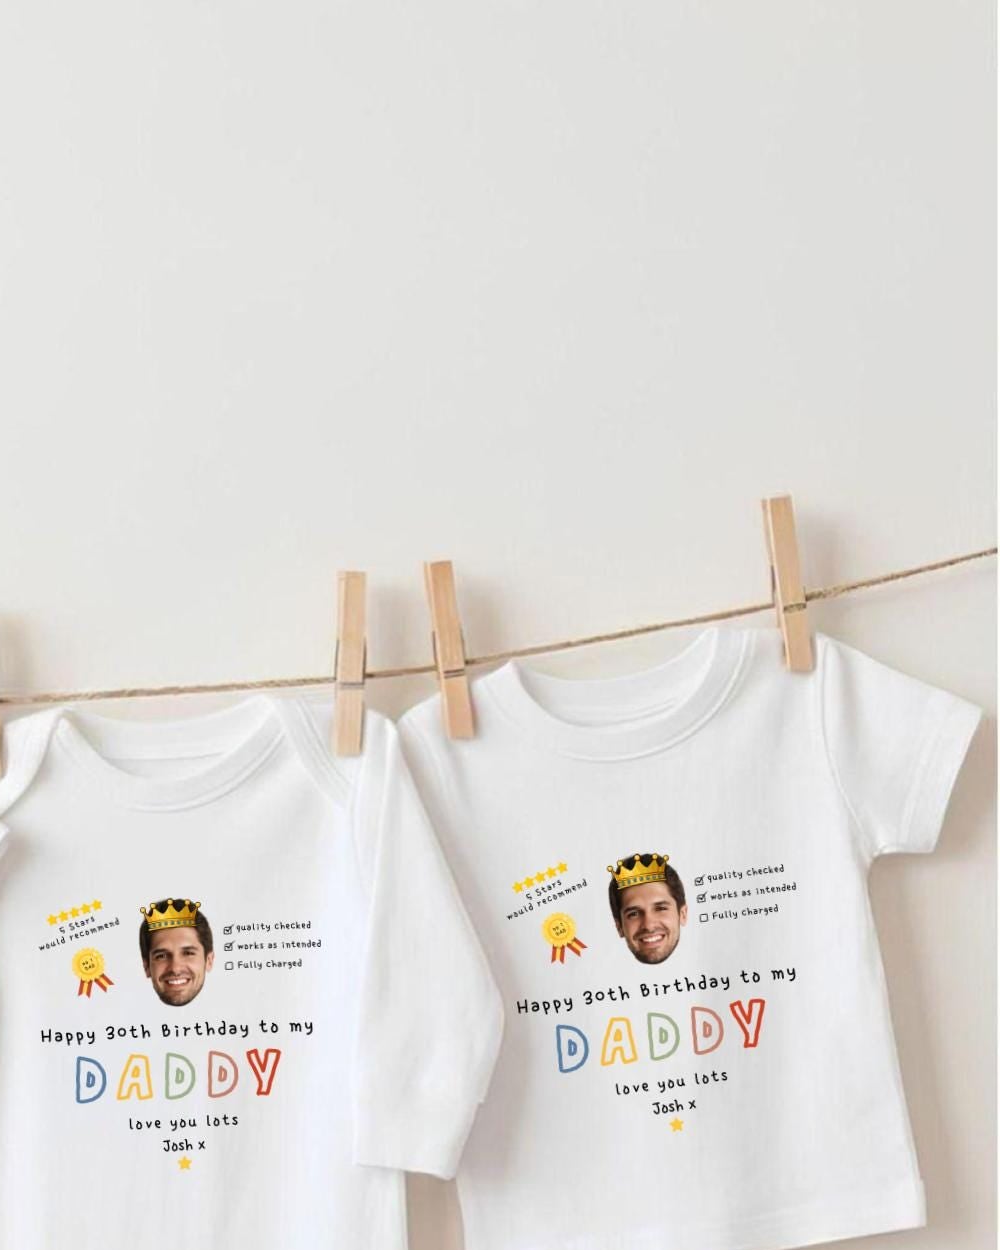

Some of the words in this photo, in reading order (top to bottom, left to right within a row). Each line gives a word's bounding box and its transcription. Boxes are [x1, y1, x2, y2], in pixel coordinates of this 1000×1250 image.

[707, 870, 744, 883] quality
[746, 864, 785, 877] checked
[525, 892, 533, 901] 5
[534, 878, 562, 896] Stars
[710, 890, 738, 902] works
[741, 888, 752, 898] as
[755, 882, 798, 896] intended
[506, 902, 534, 921] would
[536, 879, 588, 908] recommend
[741, 904, 780, 918] charged
[38, 936, 66, 952] would
[69, 918, 120, 942] recommend
[58, 926, 66, 935] 5
[68, 916, 96, 932] Stars
[236, 922, 272, 933] quality
[274, 920, 312, 931] checked
[237, 939, 265, 950] works
[268, 940, 278, 949] as
[281, 939, 322, 949] intended
[266, 958, 303, 970] charged
[516, 996, 574, 1016] Happy
[582, 985, 631, 1006] 30th
[640, 974, 731, 998] Birthday
[740, 968, 761, 984] to
[770, 966, 797, 983] my
[40, 1028, 96, 1046] Happy
[106, 1024, 152, 1040] 30th
[162, 1020, 250, 1039] Birthday
[258, 1019, 279, 1034] to
[289, 1018, 314, 1035] my
[556, 998, 766, 1074] DADDY
[75, 1048, 282, 1104] DADDY
[615, 1080, 650, 1096] love
[658, 1077, 686, 1093] you
[694, 1068, 729, 1086] lots
[652, 1098, 684, 1115] Josh
[688, 1099, 696, 1110] x
[128, 1117, 162, 1130] love
[170, 1117, 198, 1132] you
[206, 1114, 239, 1128] lots
[162, 1138, 194, 1152] Josh
[198, 1139, 206, 1150] x
